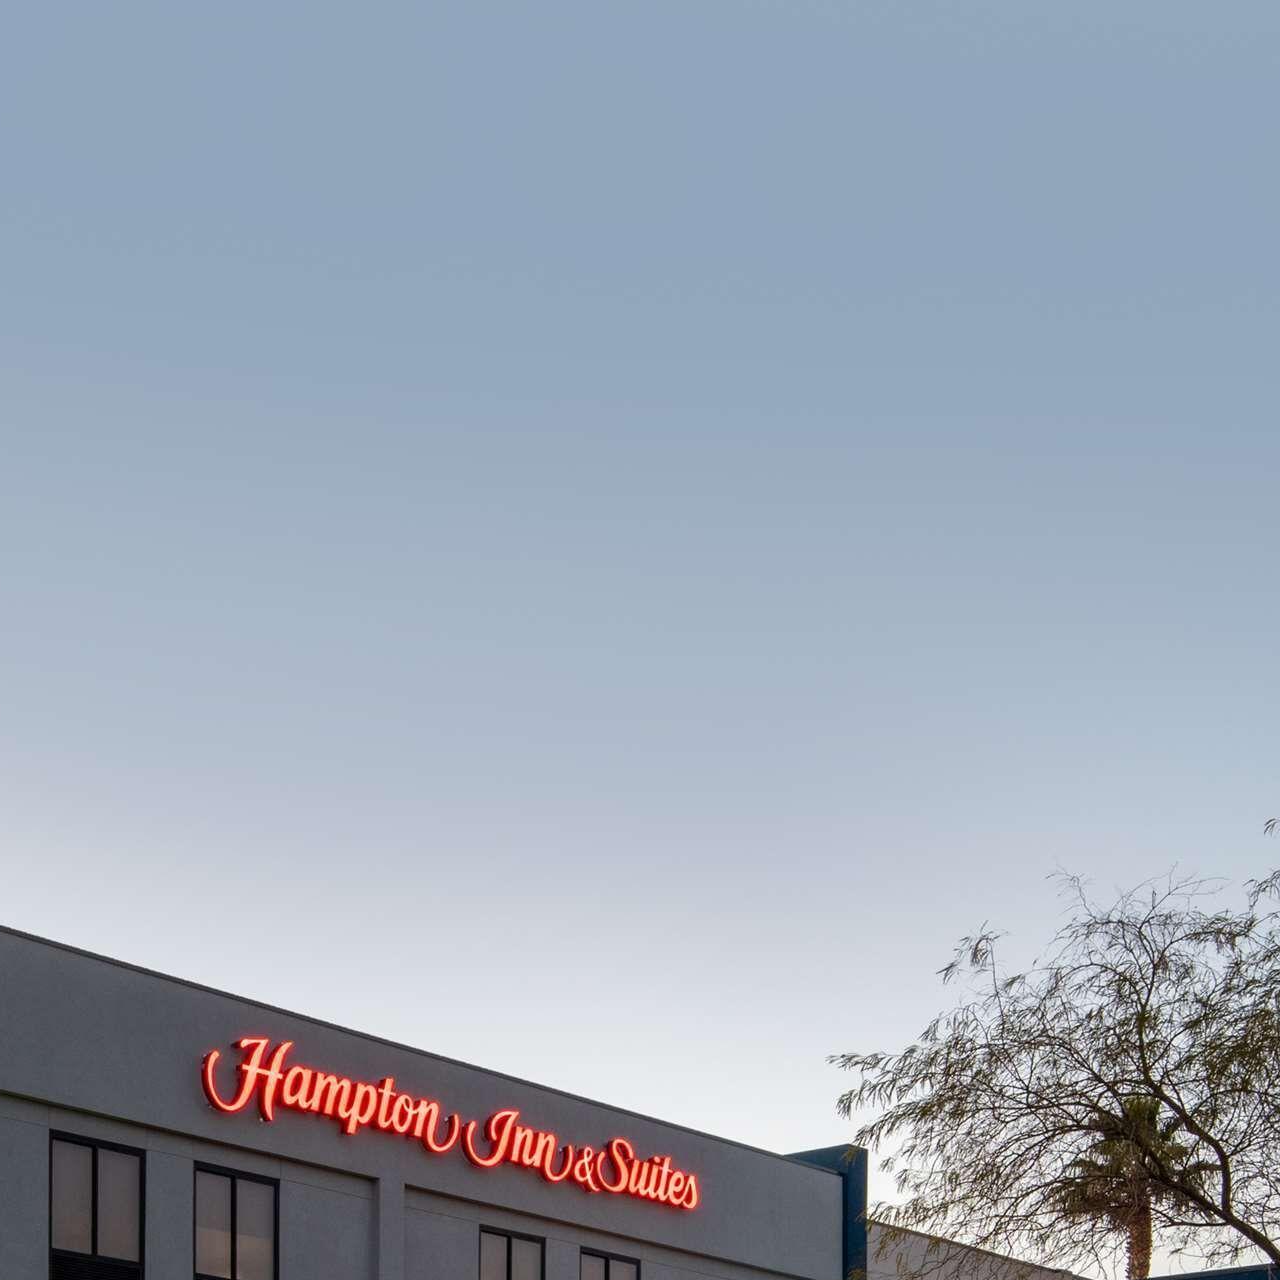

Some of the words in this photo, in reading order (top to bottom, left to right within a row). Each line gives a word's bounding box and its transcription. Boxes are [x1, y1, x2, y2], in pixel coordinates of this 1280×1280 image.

[202, 1037, 460, 1153] Hampton
[462, 1110, 574, 1182] Inn
[573, 1146, 599, 1191] &
[596, 1138, 700, 1209] Suites
